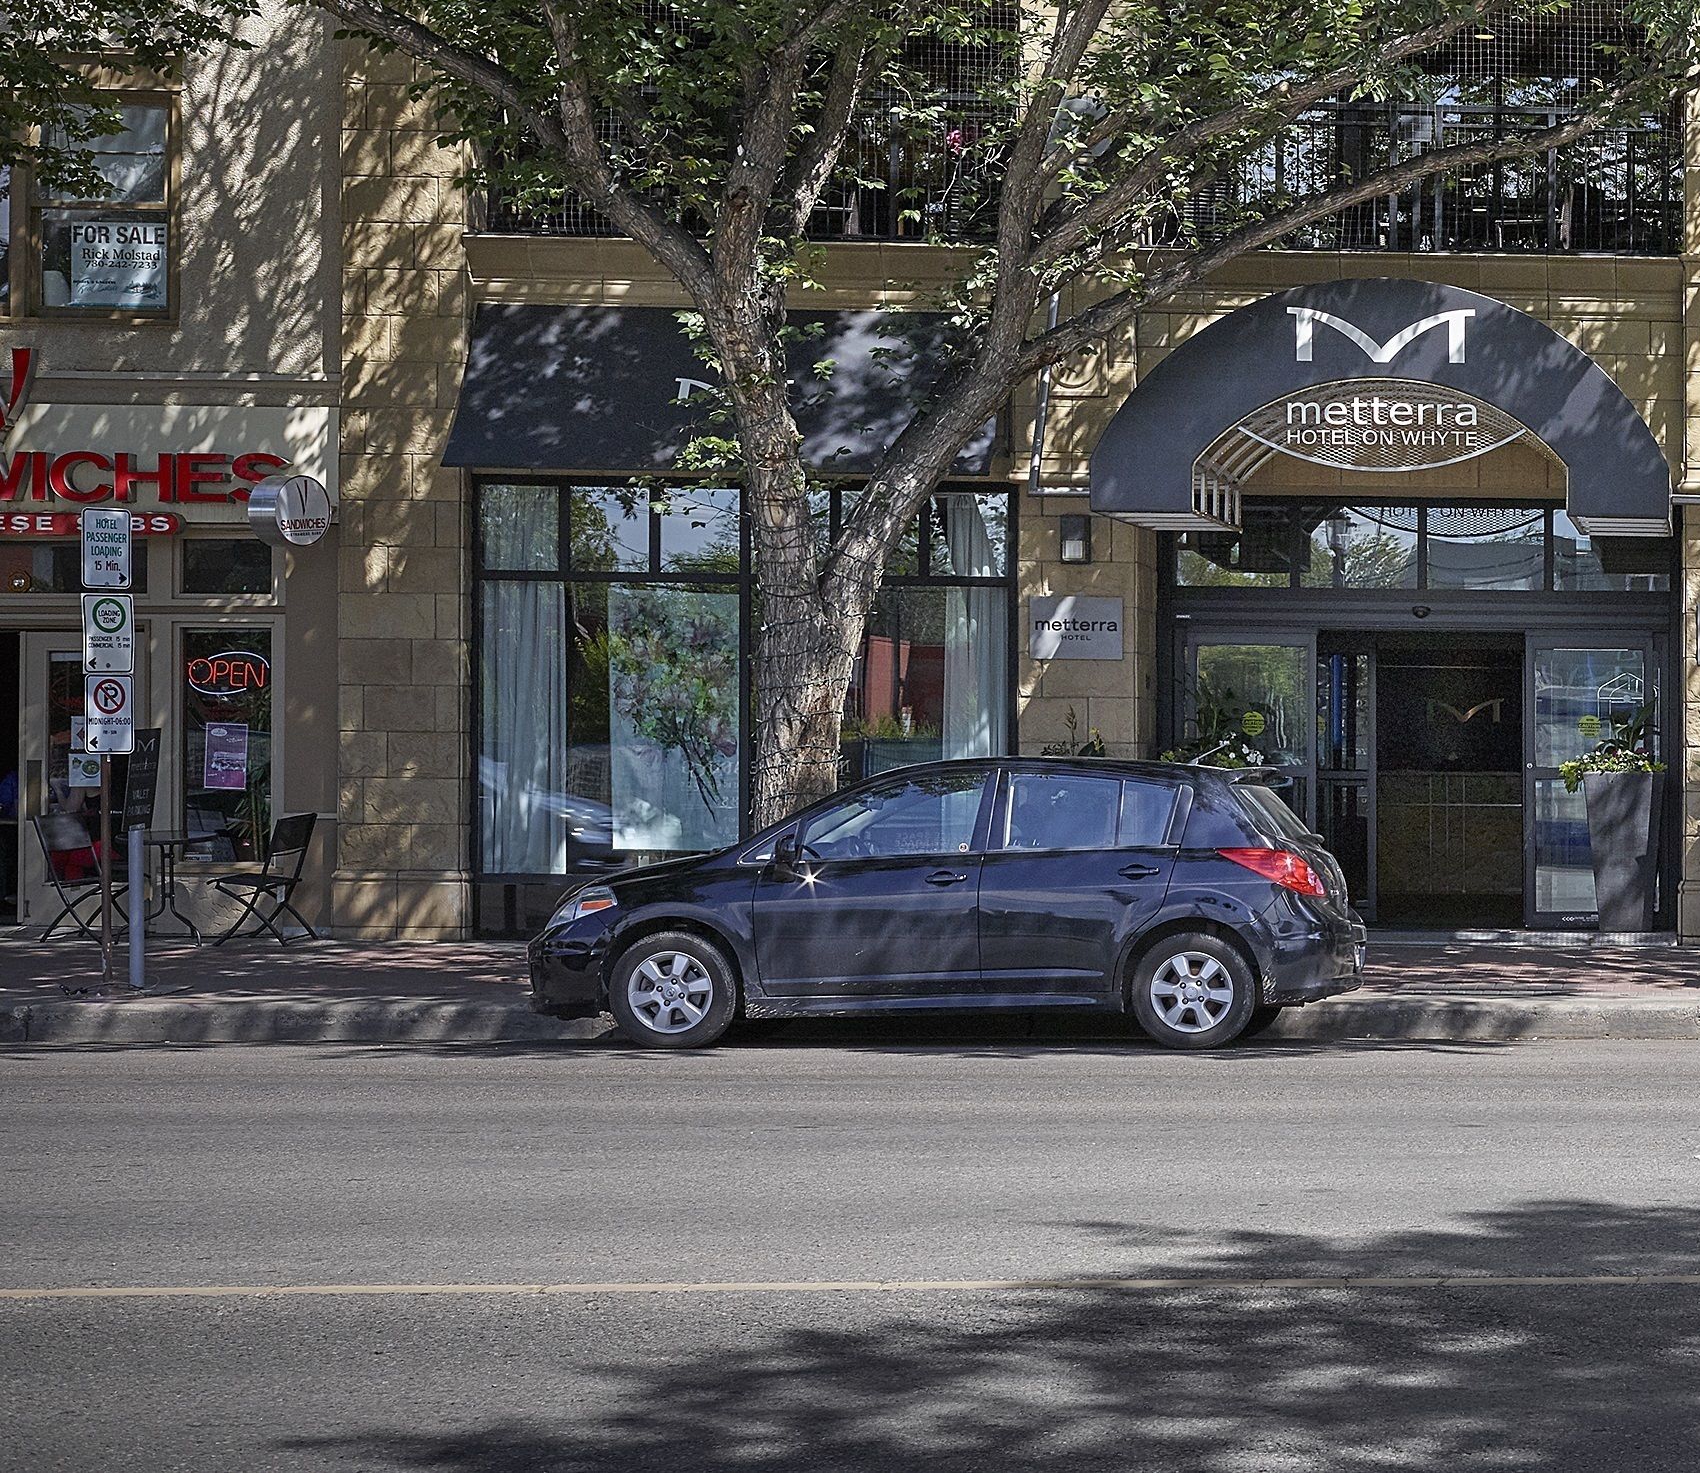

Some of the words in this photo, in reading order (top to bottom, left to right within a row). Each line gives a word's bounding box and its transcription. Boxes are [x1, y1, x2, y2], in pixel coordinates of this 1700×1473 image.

[73, 225, 110, 244] FOR
[116, 226, 165, 245] SALE
[82, 247, 110, 260] Rick
[113, 248, 160, 261] Molstad
[1286, 396, 1478, 426] metterra
[1287, 429, 1356, 445] HOTEL
[1362, 429, 1394, 446] ON
[1400, 430, 1478, 446] WHYTE
[95, 518, 118, 530] HOTEL
[280, 517, 326, 531] SANDWICHES
[86, 532, 127, 543] PASSENGER
[91, 545, 122, 557] LOADING
[95, 560, 102, 571] 15
[1034, 618, 1118, 632] metterra
[188, 658, 266, 688] OPEN
